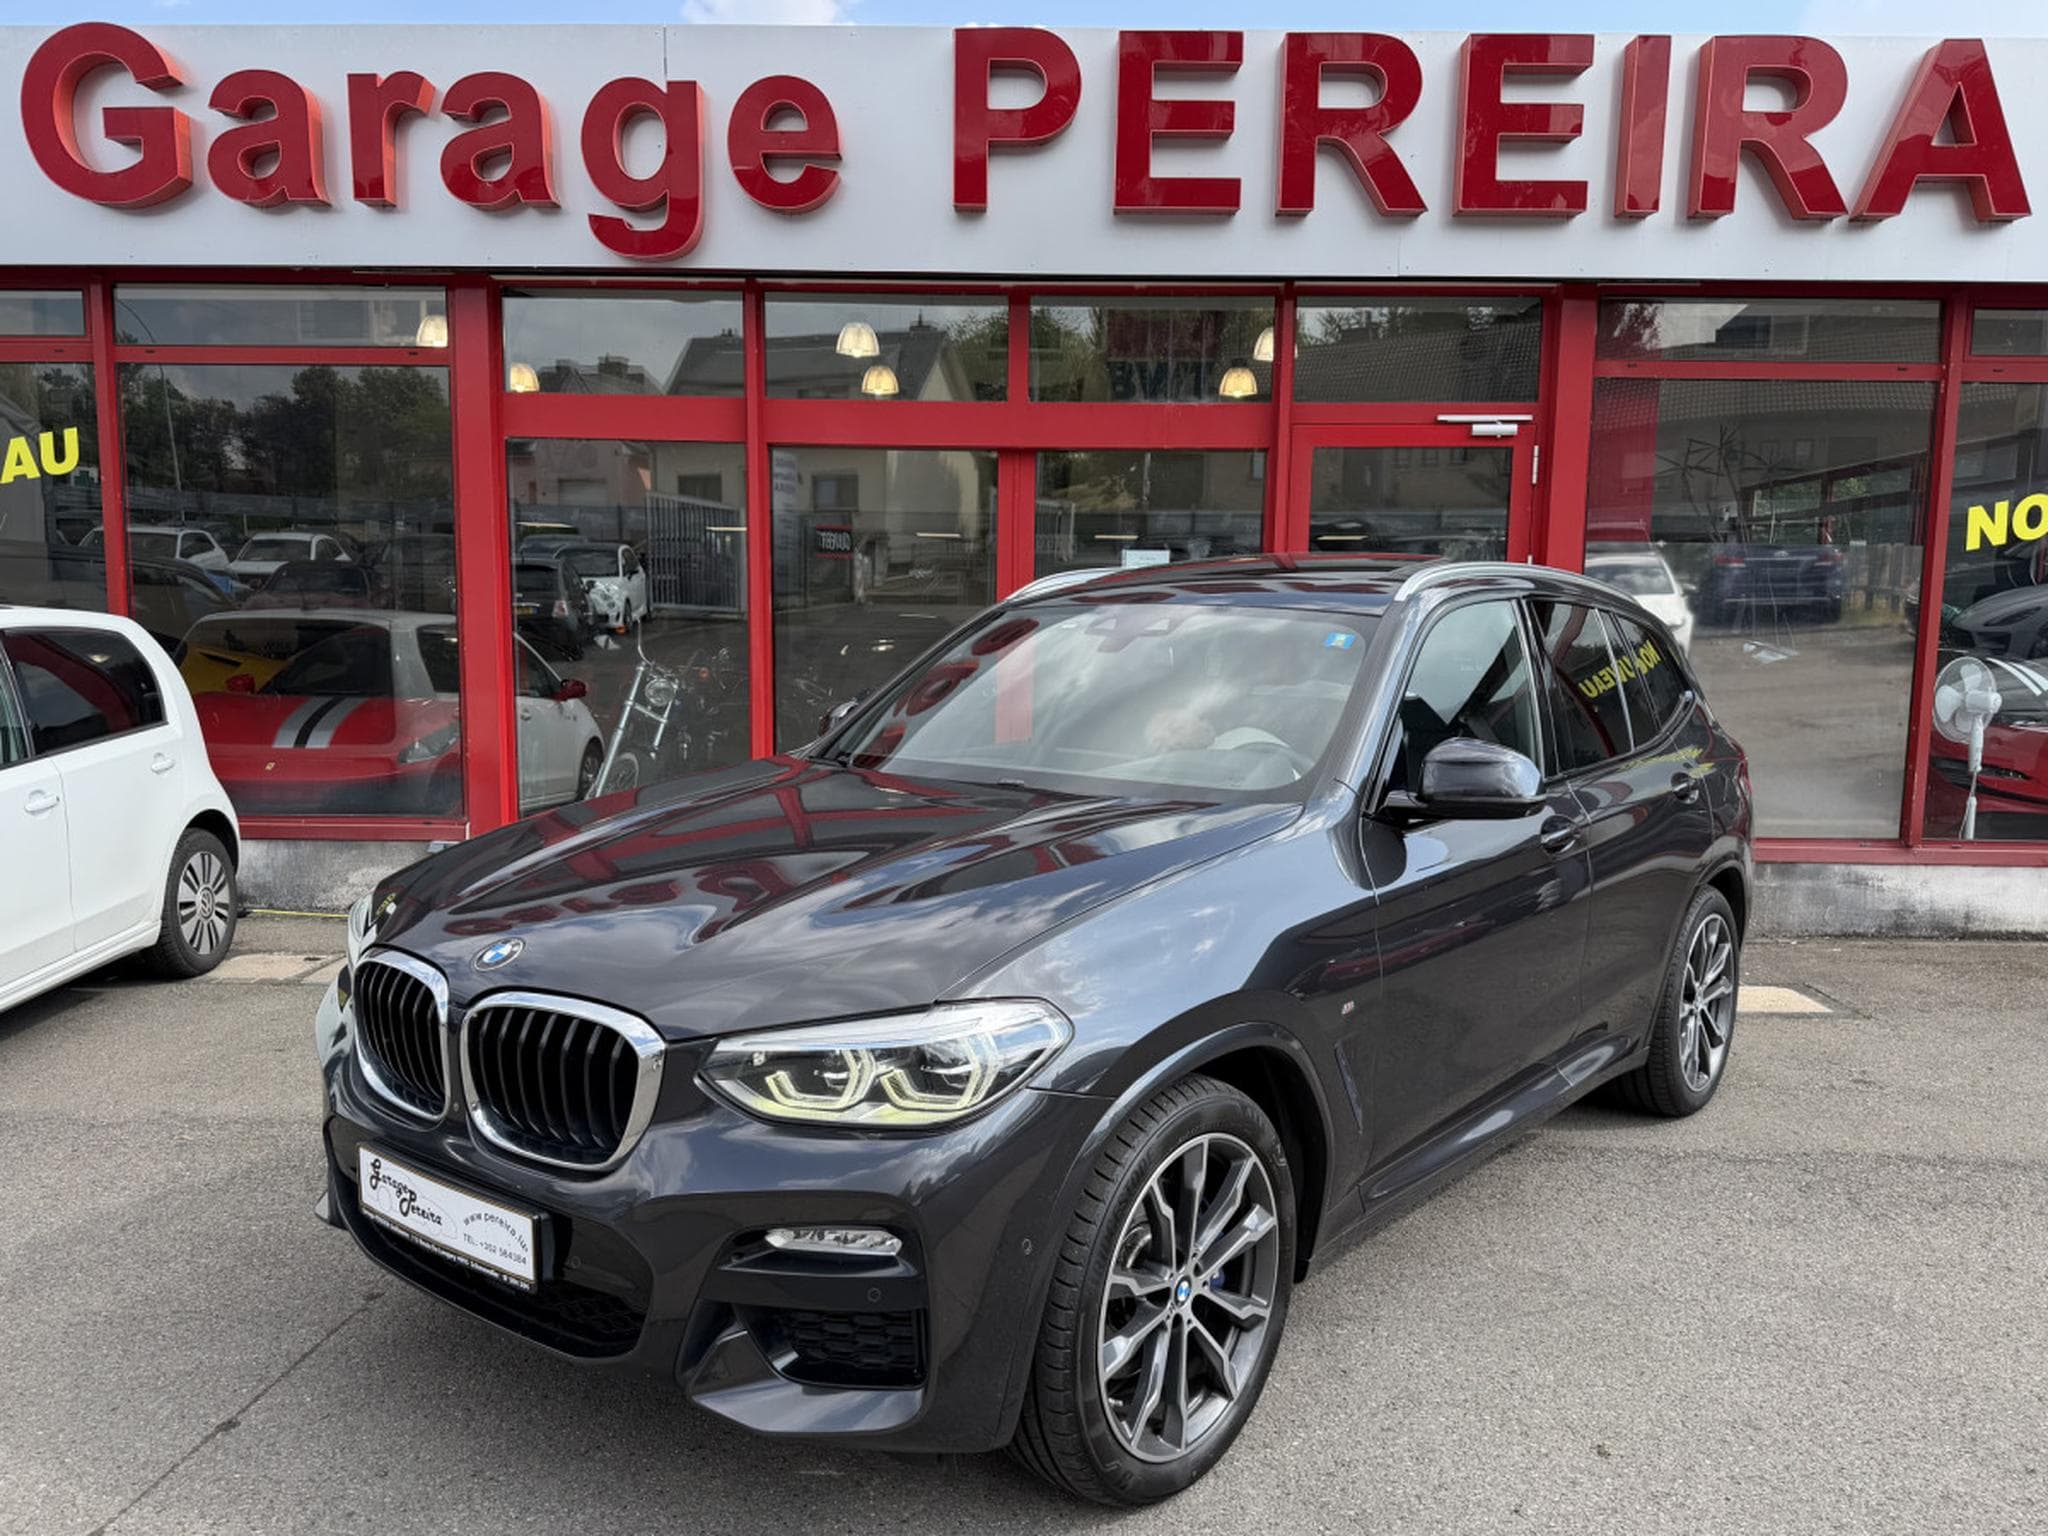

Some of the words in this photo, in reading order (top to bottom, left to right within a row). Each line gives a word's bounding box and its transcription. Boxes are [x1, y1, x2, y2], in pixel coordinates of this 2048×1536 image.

[20, 22, 843, 262] Garage
[954, 27, 2034, 225] PEREIRA
[0, 427, 79, 484] AU
[1965, 493, 2048, 551] NO
